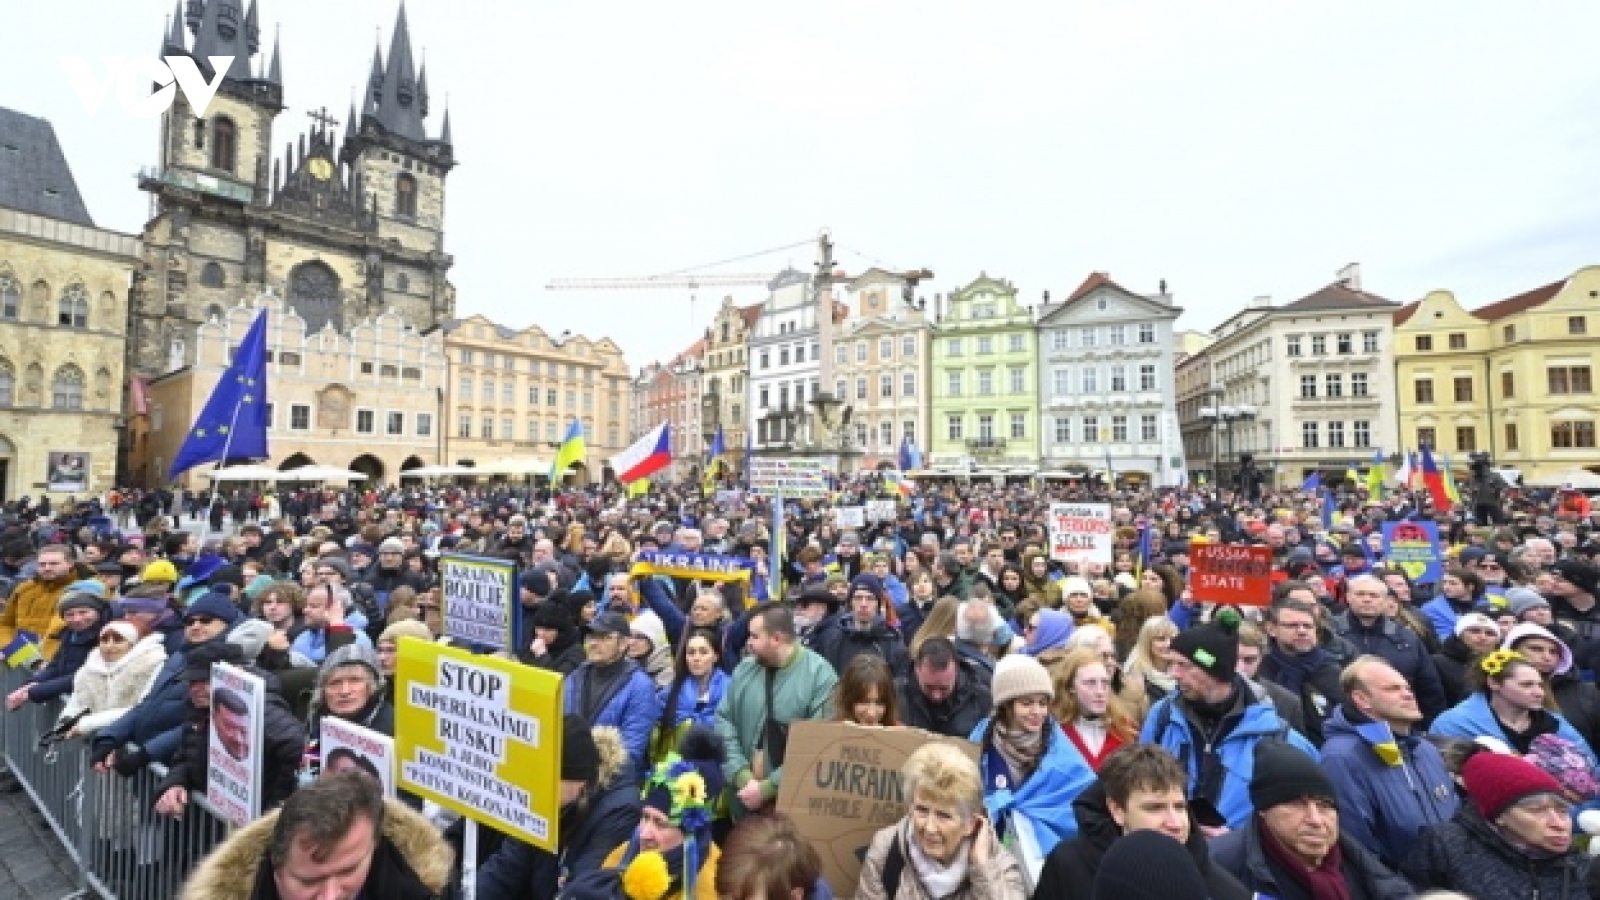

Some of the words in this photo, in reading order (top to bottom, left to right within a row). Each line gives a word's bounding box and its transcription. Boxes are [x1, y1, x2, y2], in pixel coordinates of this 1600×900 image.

[1200, 574, 1245, 590] STATE
[440, 661, 502, 700] STOP
[411, 686, 535, 742] IMPERIÁLNÍMU
[439, 717, 501, 757] RUSKU
[450, 745, 457, 760] A
[460, 749, 493, 773] JEHO
[839, 746, 882, 765] MAKE
[815, 761, 905, 804] UKRAIN
[809, 796, 862, 820] WHOLE
